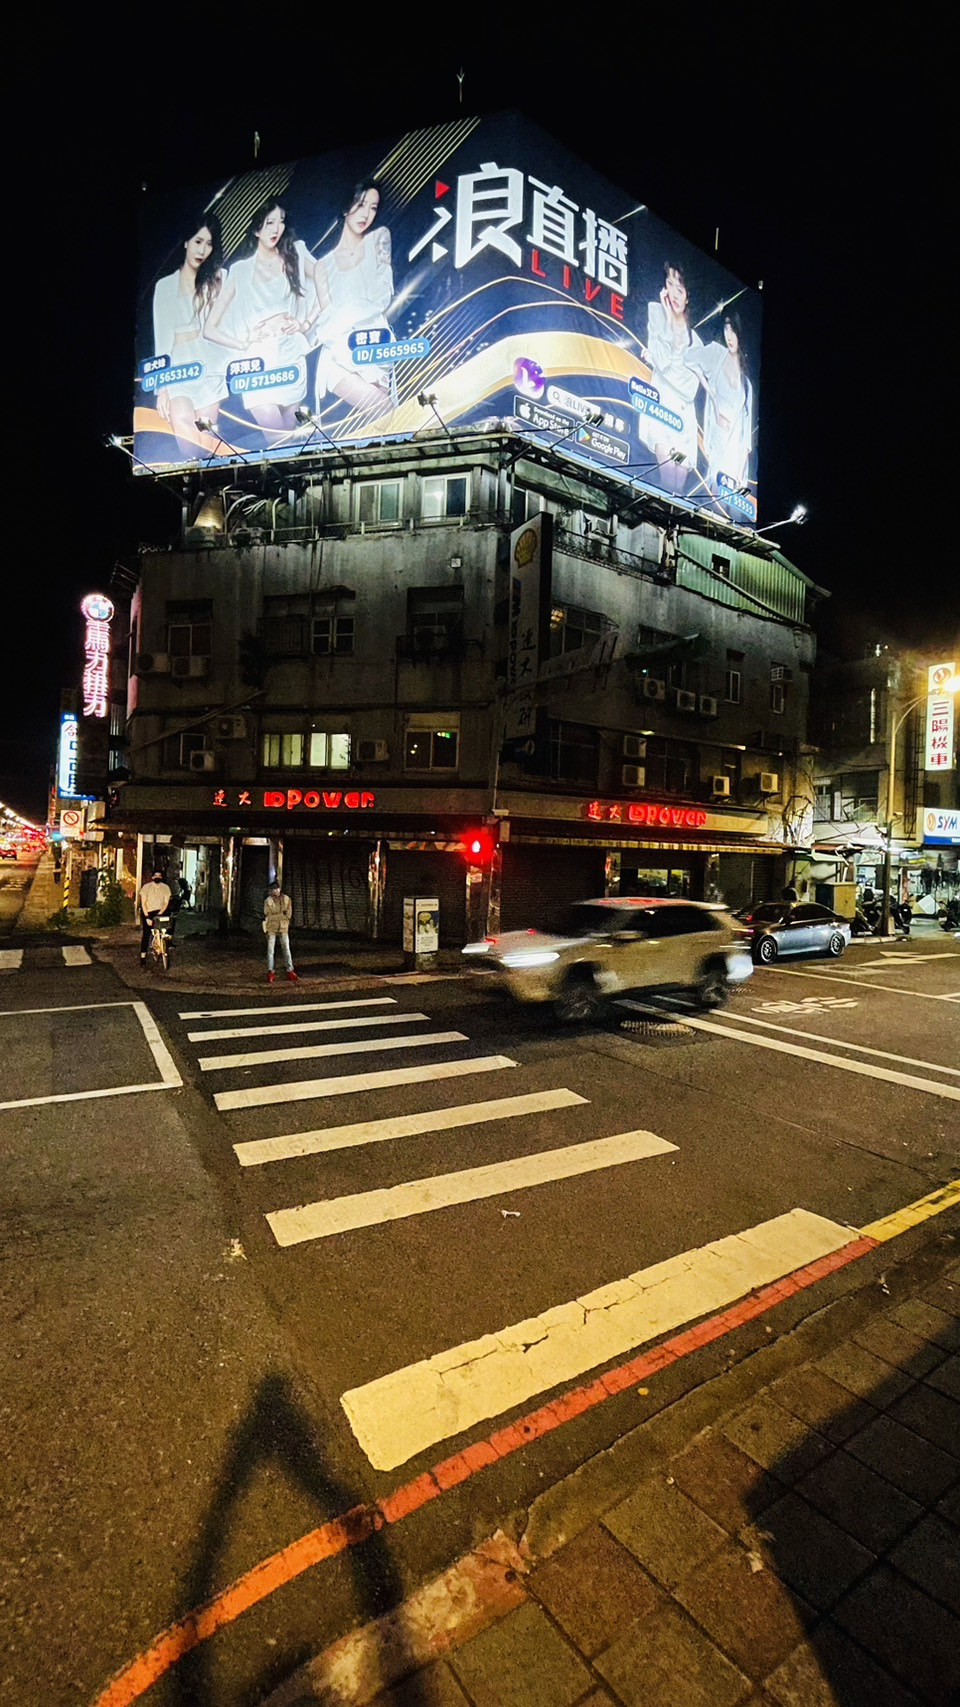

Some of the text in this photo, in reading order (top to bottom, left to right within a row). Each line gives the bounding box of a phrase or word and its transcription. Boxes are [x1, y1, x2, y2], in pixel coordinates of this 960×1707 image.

[409, 161, 628, 296] 浪直播
[531, 249, 625, 320] LIVE
[375, 342, 425, 359] 5665965
[159, 366, 200, 384] 5653142
[251, 370, 295, 388] 5719686
[533, 413, 570, 437] App Store
[591, 438, 626, 460] Google Play
[930, 700, 949, 767] 三陽機車
[937, 815, 958, 831] SYM
